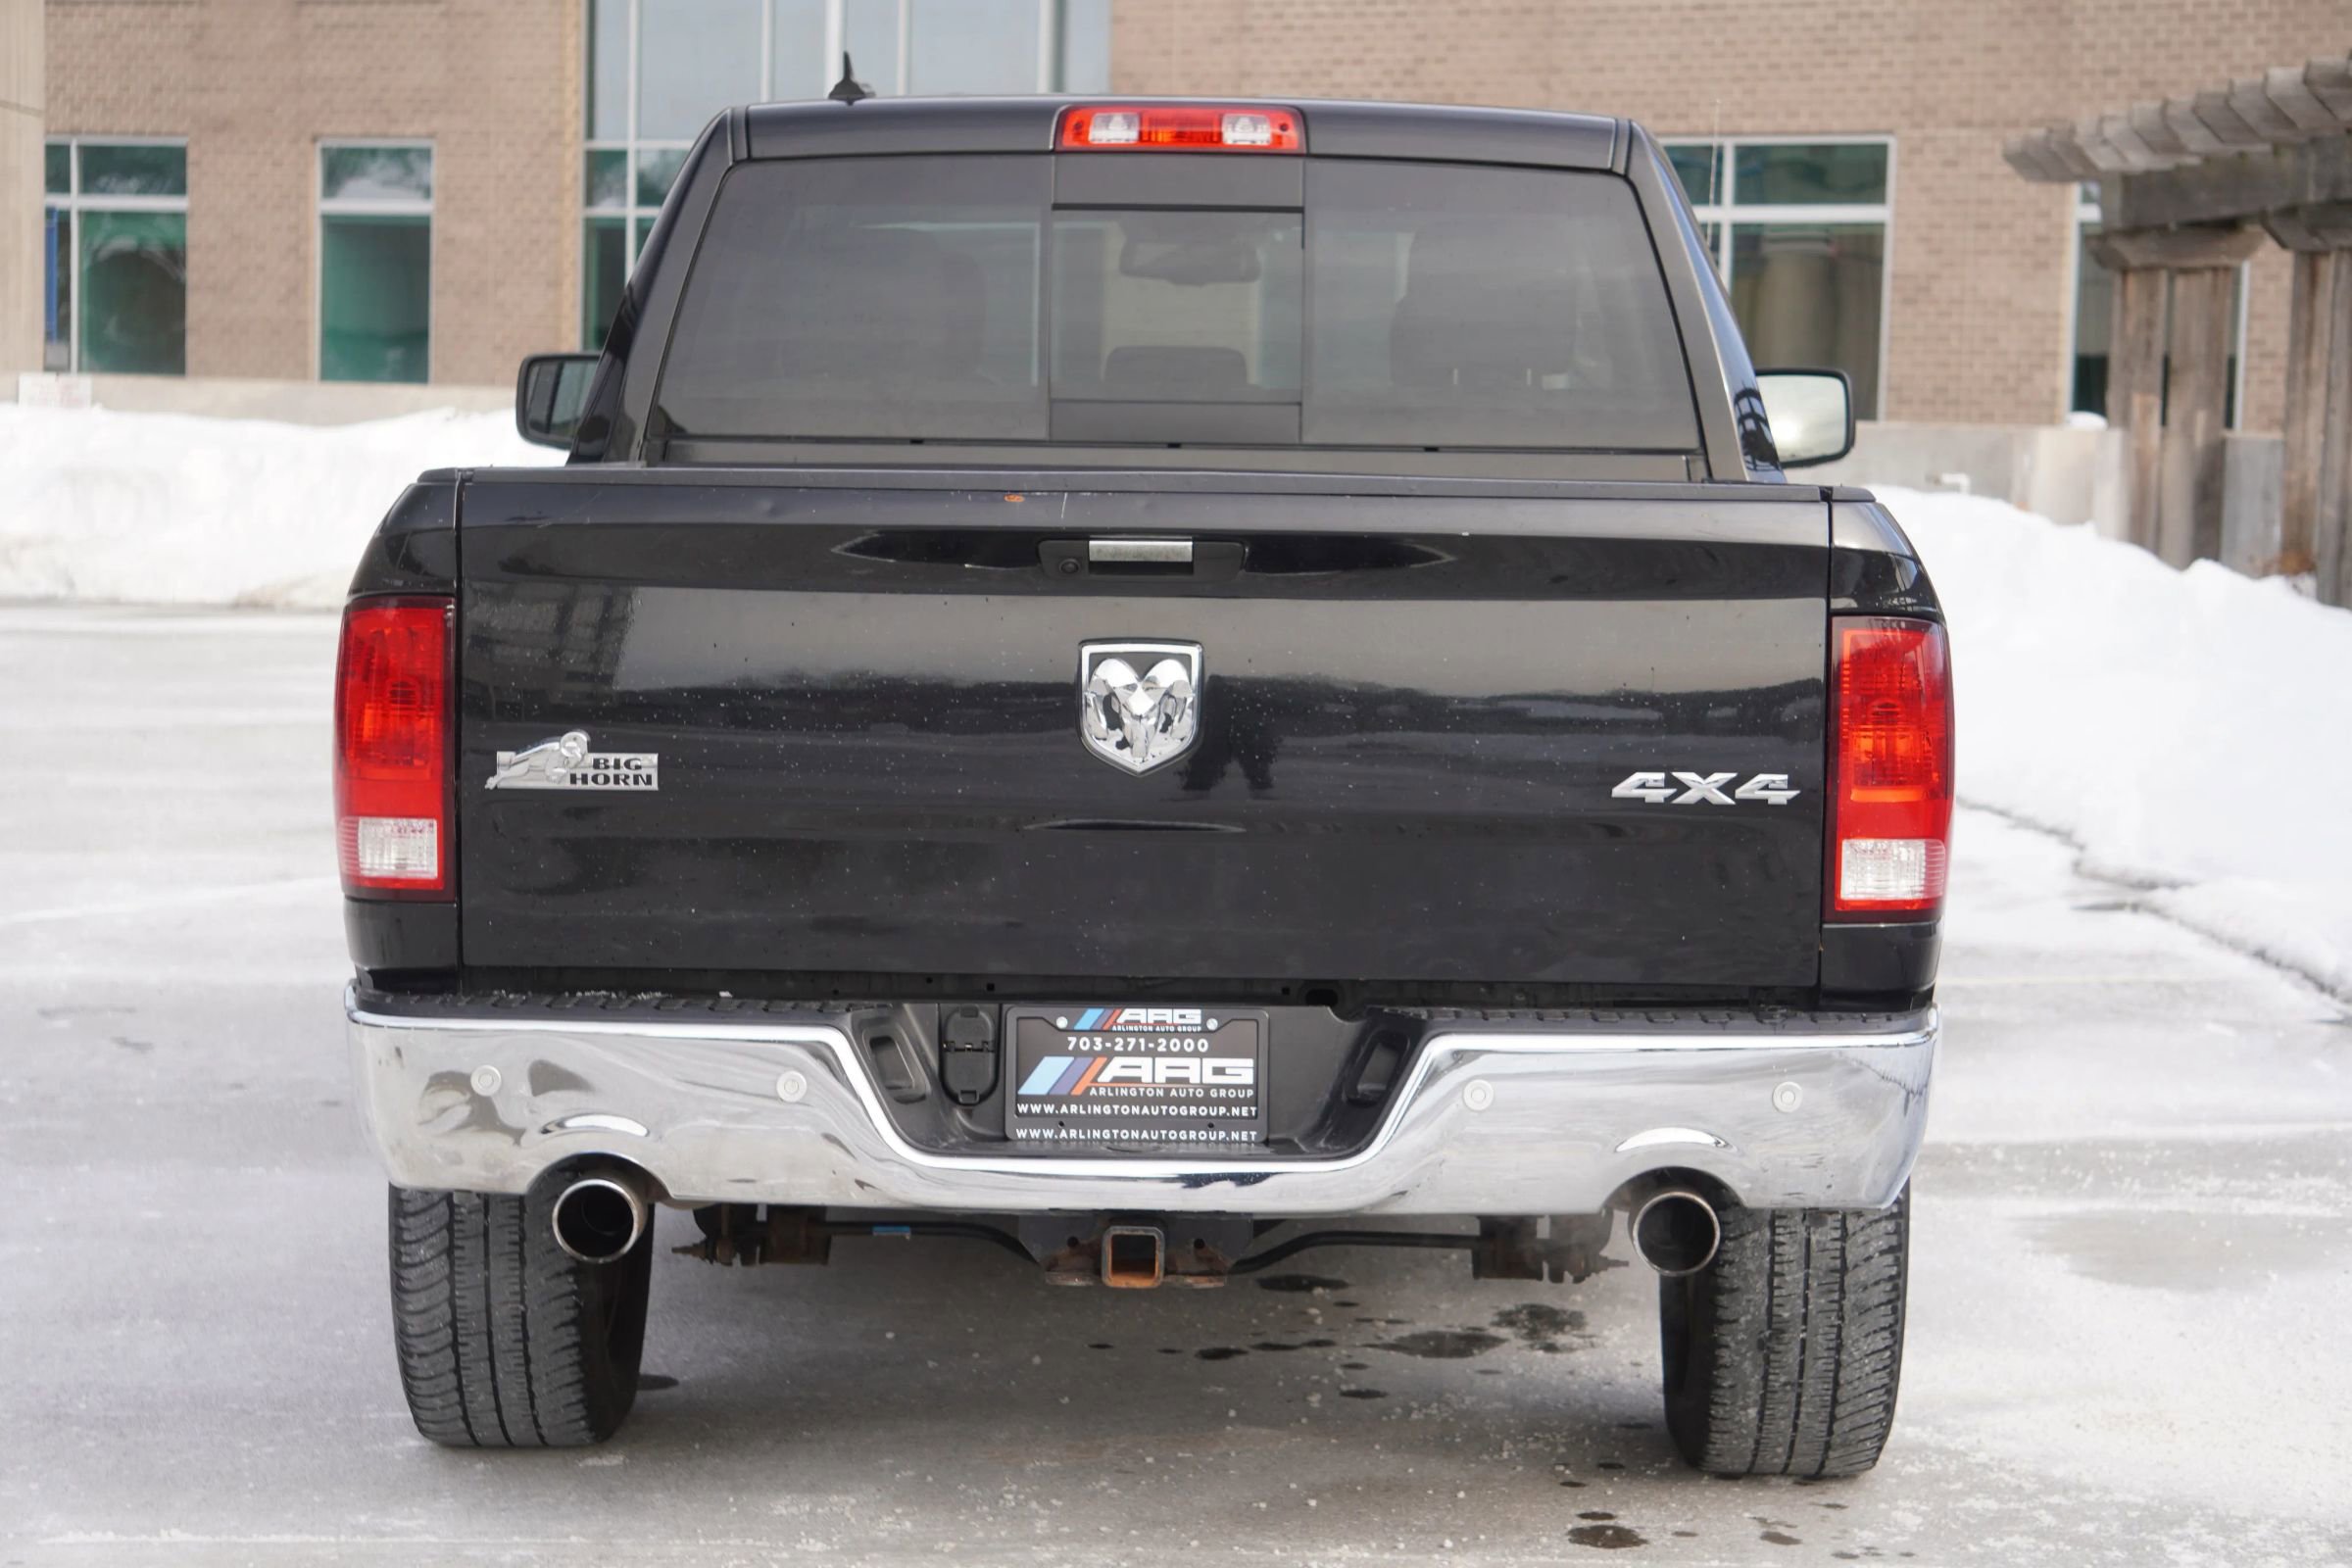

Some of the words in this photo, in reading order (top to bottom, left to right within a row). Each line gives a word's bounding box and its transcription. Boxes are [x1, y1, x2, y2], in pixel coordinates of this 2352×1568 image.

[592, 758, 642, 770] BIG
[569, 772, 653, 786] HORN
[1611, 771, 1801, 806] 4X4
[1115, 1008, 1201, 1024] AAG
[1067, 1036, 1209, 1053] 703-271-2000
[1097, 1056, 1254, 1085] AAG
[1089, 1087, 1164, 1098] ARLINGTON
[1169, 1088, 1204, 1098] AUTO
[1209, 1089, 1254, 1099] GROUP
[1017, 1103, 1257, 1117] WWW.ARLINGTONAUTOGROUP.NET
[1015, 1128, 1257, 1142] WWW.ARLINGTONAUTOGROUP.NET
